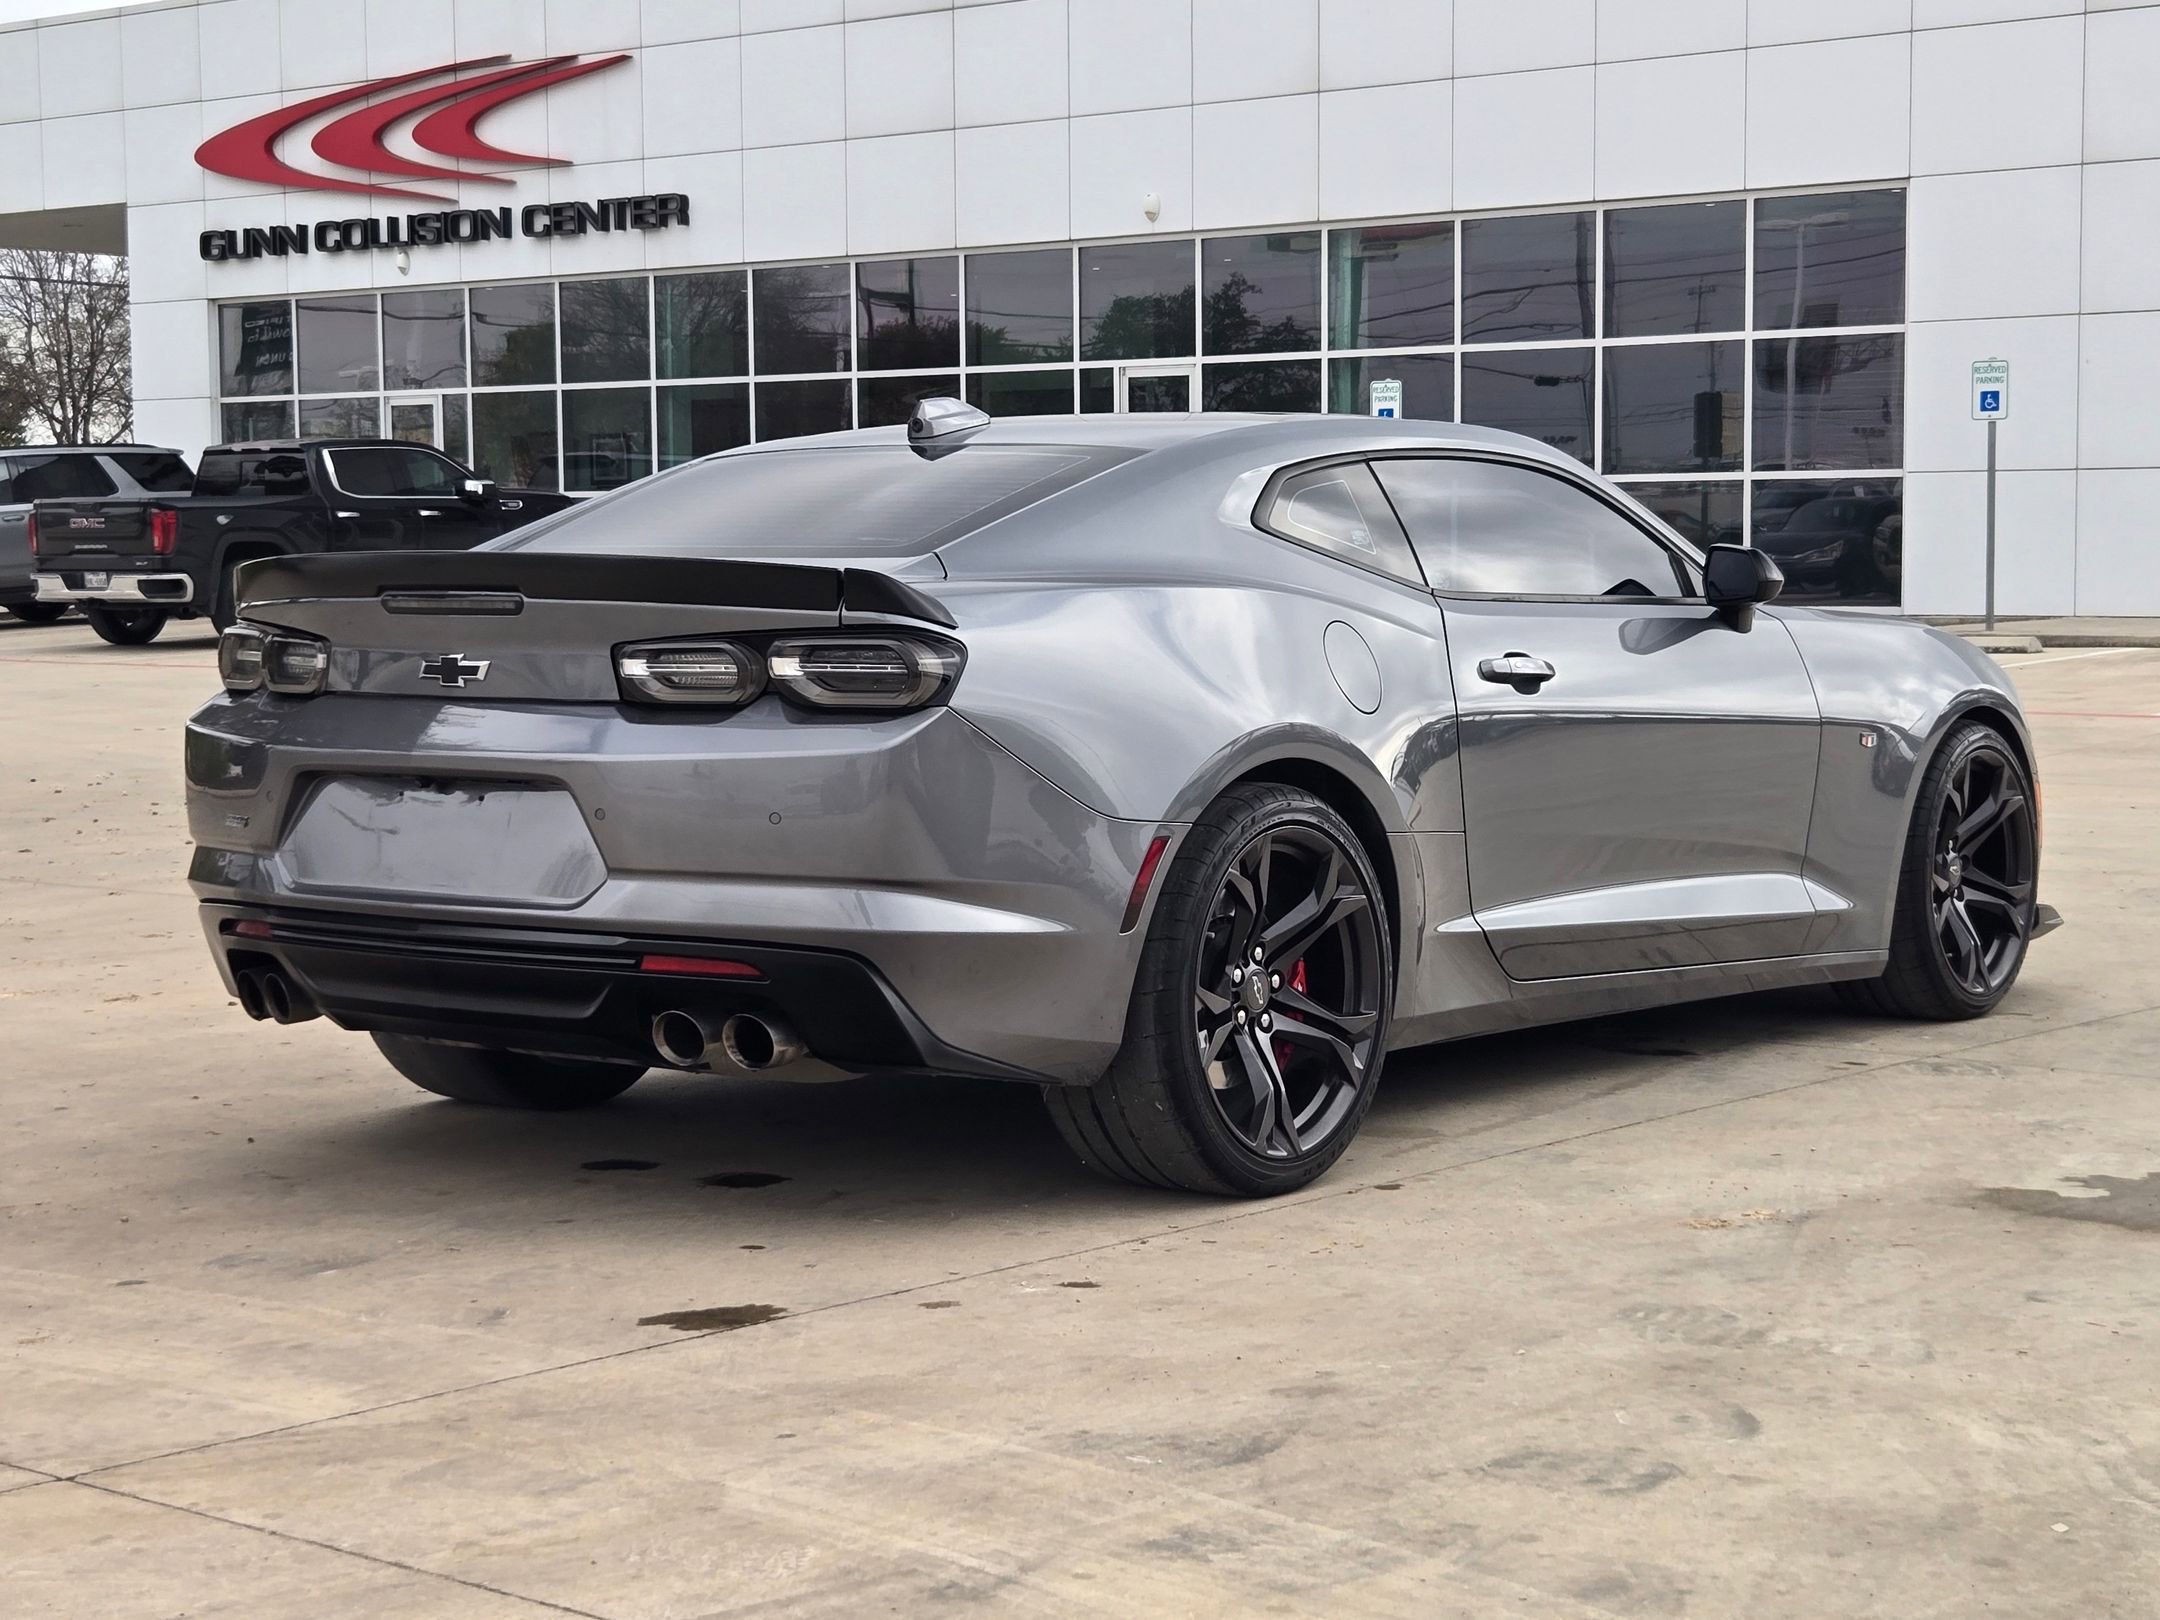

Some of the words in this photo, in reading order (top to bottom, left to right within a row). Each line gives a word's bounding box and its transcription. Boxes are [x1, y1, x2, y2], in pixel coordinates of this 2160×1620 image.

[200, 224, 309, 261] GUNN
[314, 206, 513, 253] COLLISION
[522, 194, 690, 238] CENTER
[1974, 365, 2007, 375] RESERVED
[1975, 376, 2005, 385] PARKING
[1373, 385, 1400, 394] RESERVED
[70, 517, 105, 528] GMC
